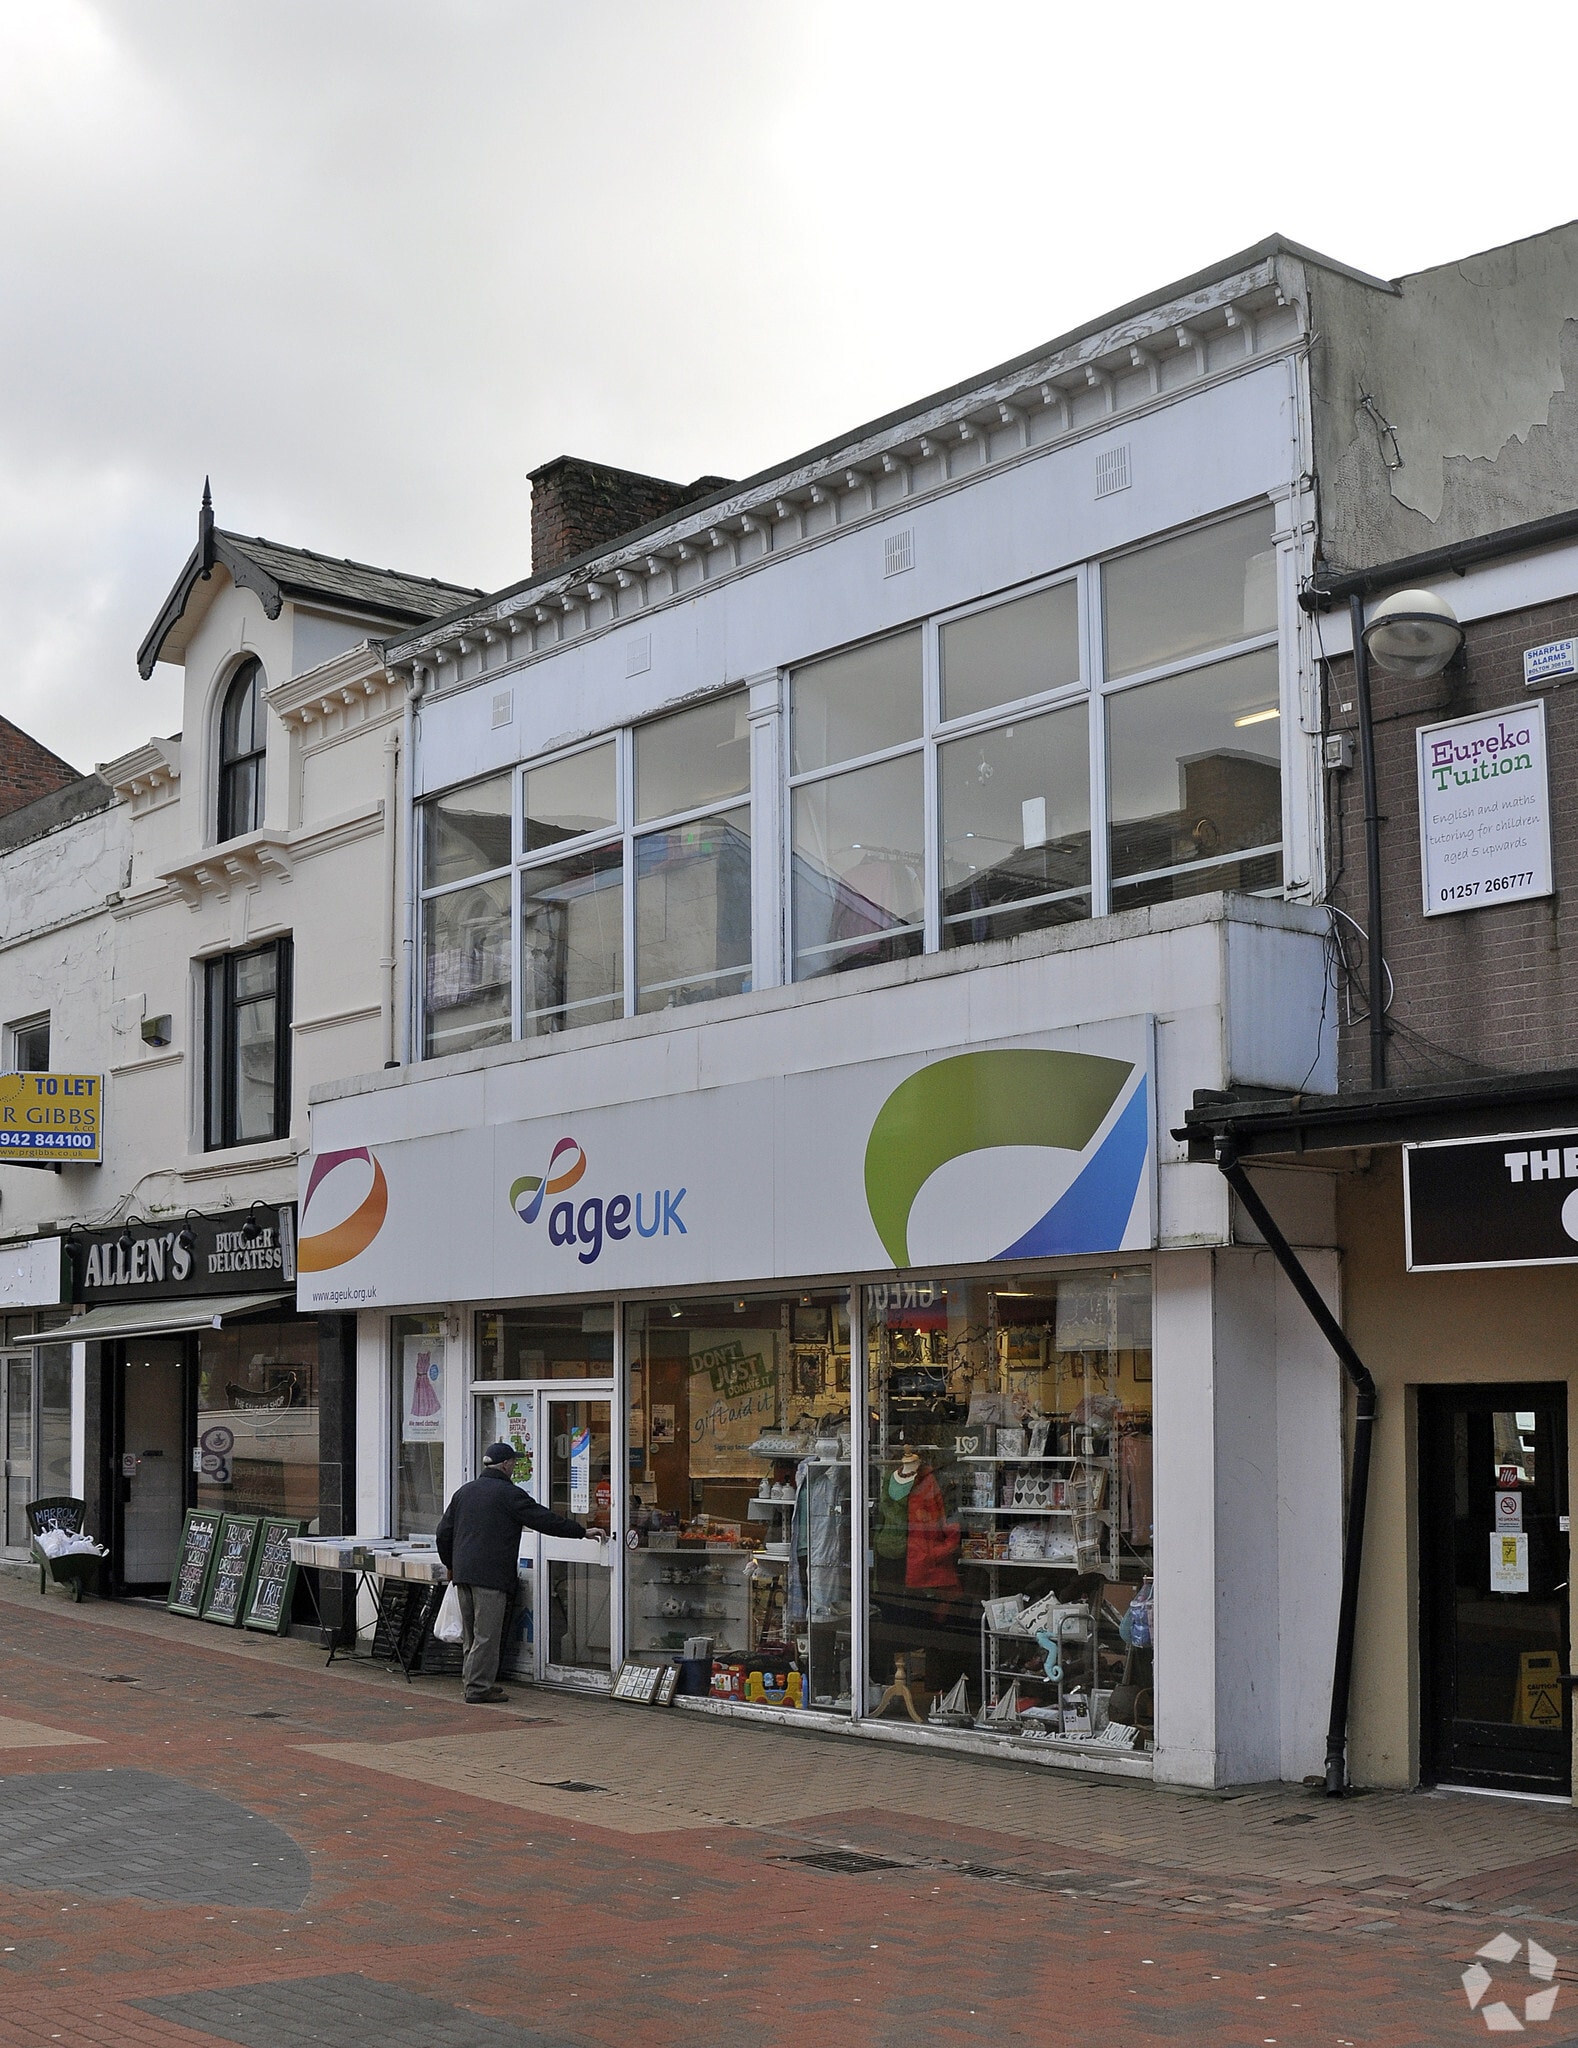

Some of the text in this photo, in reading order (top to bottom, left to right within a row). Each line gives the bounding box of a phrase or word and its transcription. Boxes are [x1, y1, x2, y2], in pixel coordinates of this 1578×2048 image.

[1527, 642, 1571, 660] SHARPLES
[1533, 652, 1566, 667] ALARMS
[1431, 723, 1530, 767] Eureka
[1432, 753, 1533, 791] Tuition
[1432, 794, 1536, 825] English and maths
[1429, 814, 1540, 845] tutoring for children
[1443, 837, 1528, 865] aged 5 upwards
[1440, 871, 1534, 902] 01257 266777
[35, 1078, 96, 1096] TO LET
[3, 1107, 96, 1125] R GIBBS
[0, 1132, 92, 1147] 942 844100
[1504, 1147, 1578, 1183] THE
[84, 1231, 191, 1287] ALLEN'S
[208, 1248, 283, 1274] DELICATESS
[312, 1286, 377, 1302] www.ageuk.org.uk
[715, 1358, 759, 1389] JUST
[727, 1379, 761, 1396] DONATE
[690, 1392, 775, 1444] gift aid it
[1500, 1469, 1517, 1485] illy
[35, 1507, 79, 1524] MARROW
[277, 1528, 288, 1546] 2
